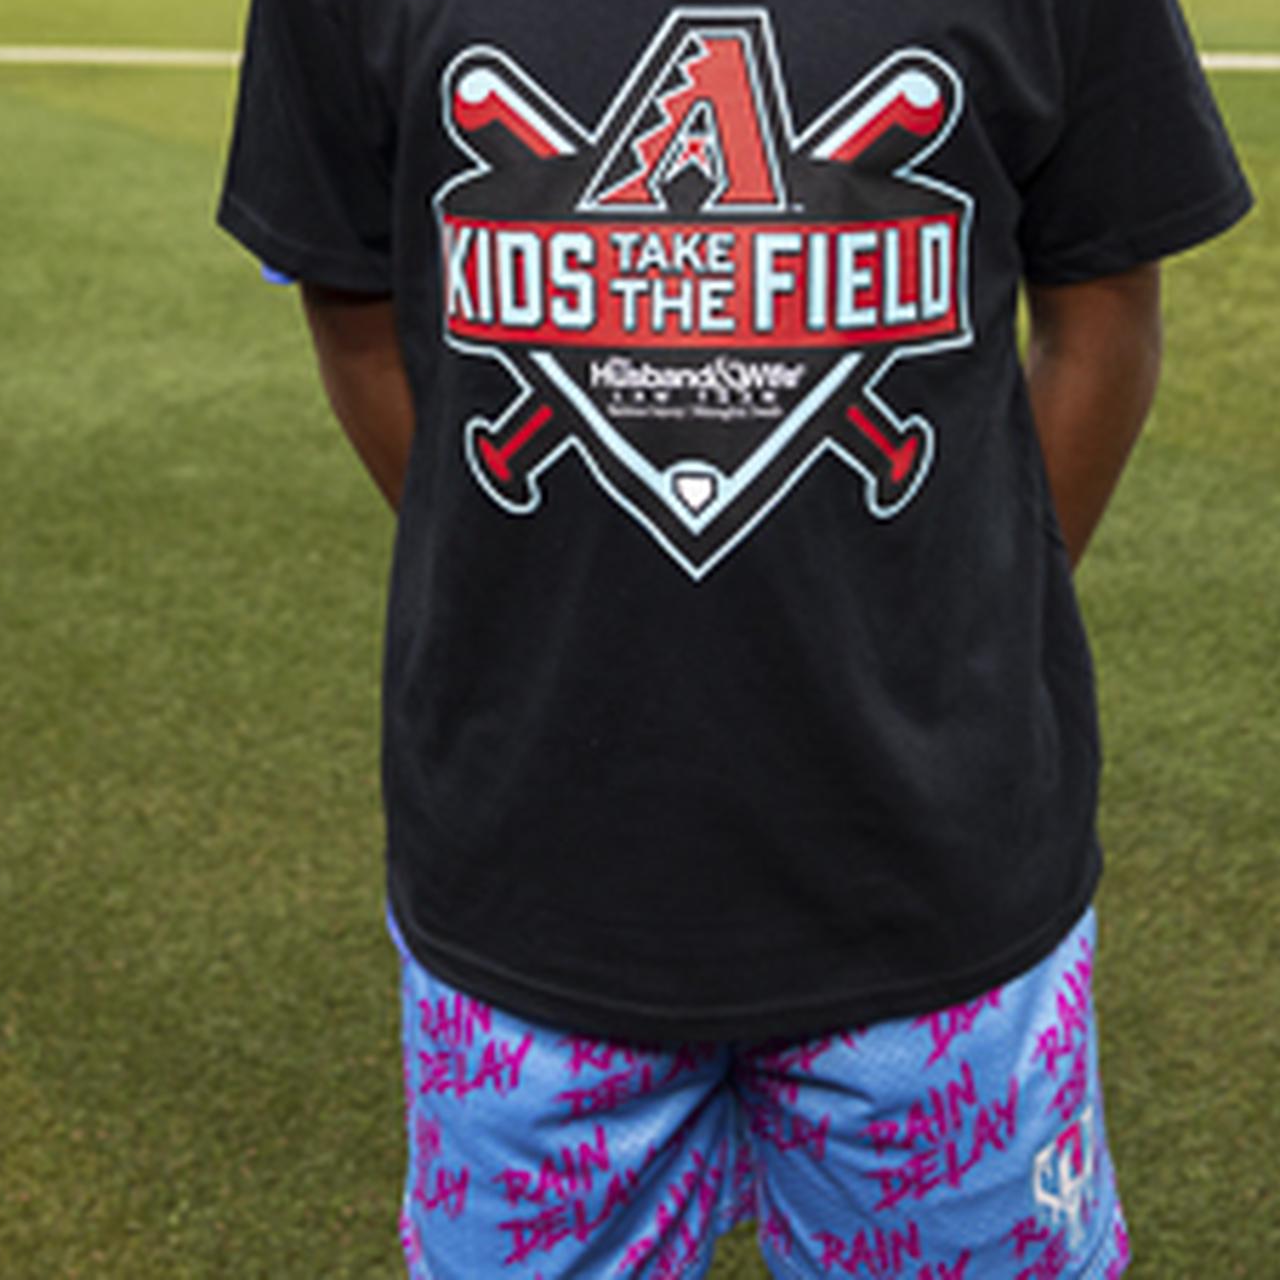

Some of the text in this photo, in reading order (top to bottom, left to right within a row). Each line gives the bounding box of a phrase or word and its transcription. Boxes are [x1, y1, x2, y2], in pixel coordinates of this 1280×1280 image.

[446, 222, 952, 333] KIDS TAKE FIELD
[610, 278, 735, 334] THE
[492, 1124, 611, 1208] RAIN
[867, 1072, 1020, 1213] DELAY
